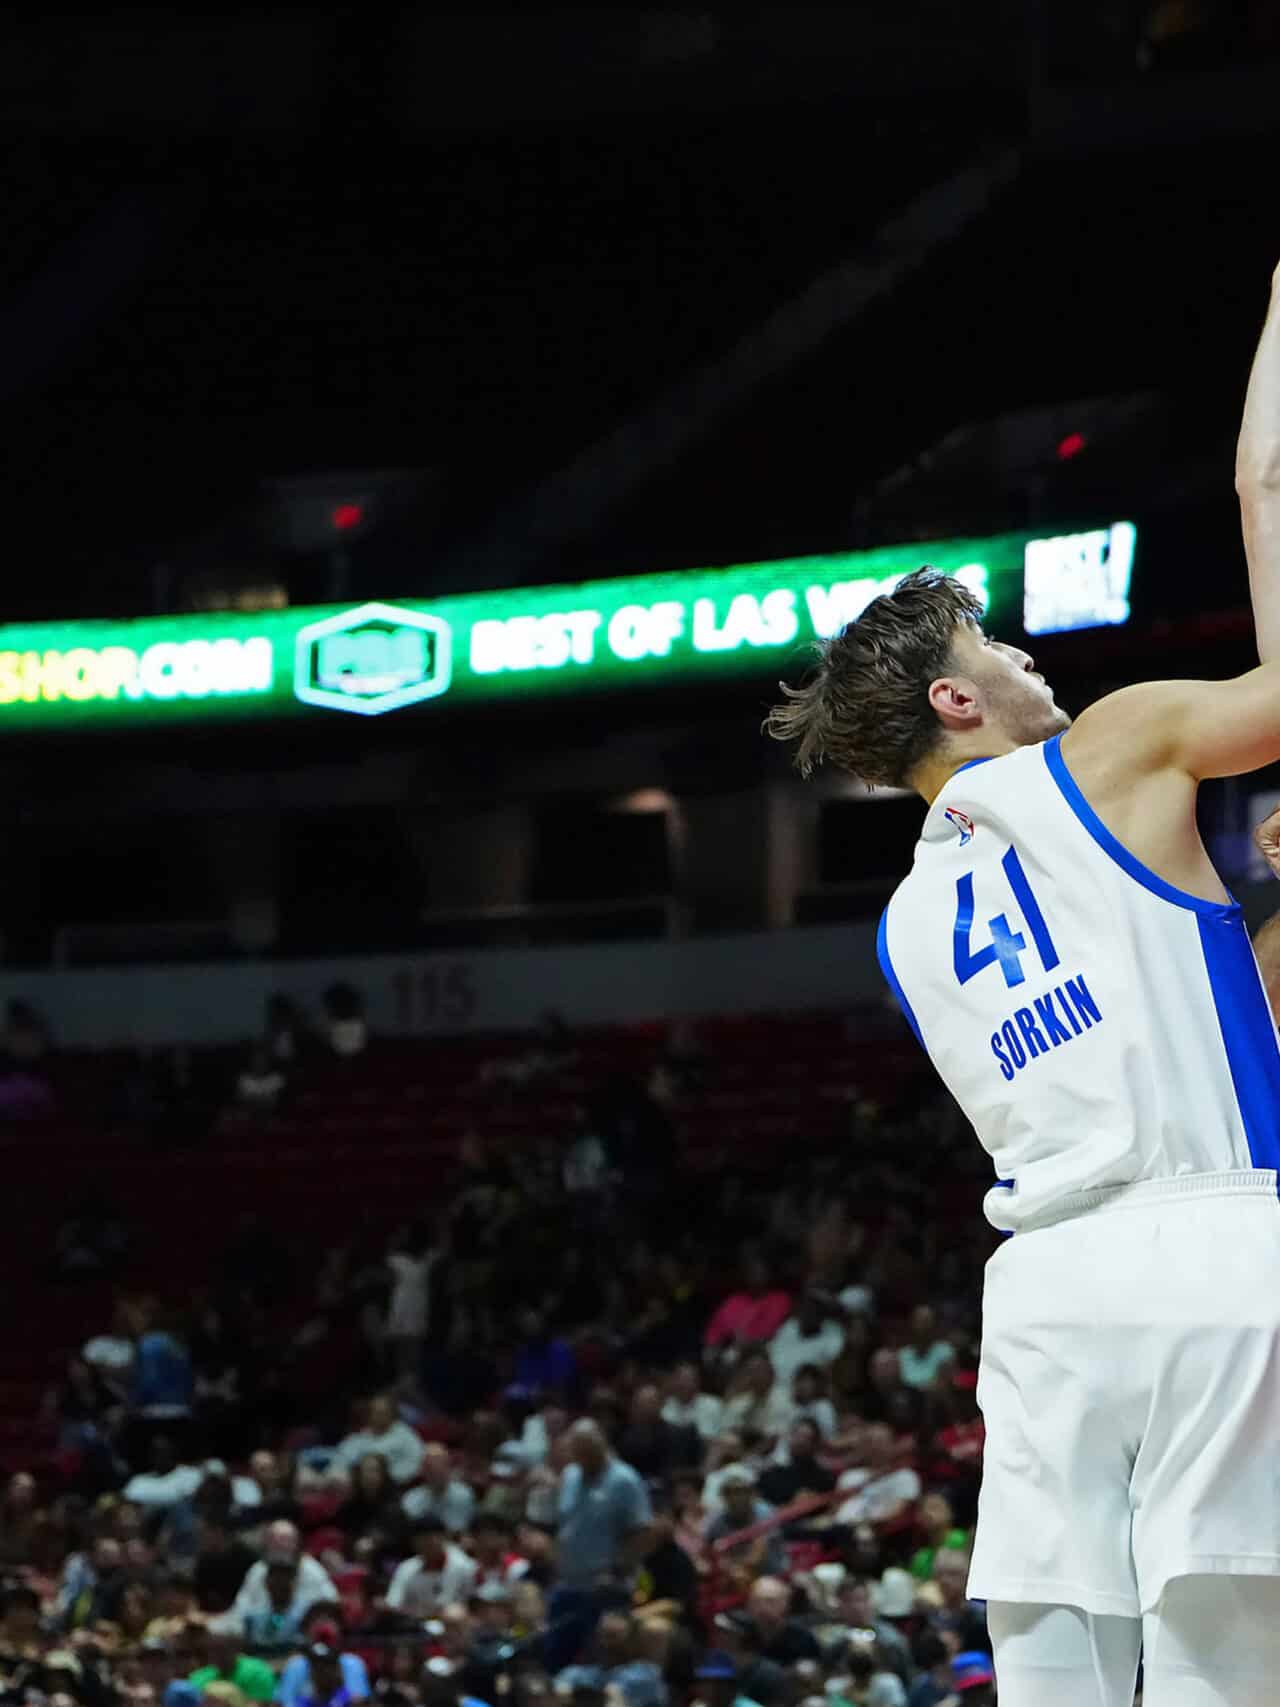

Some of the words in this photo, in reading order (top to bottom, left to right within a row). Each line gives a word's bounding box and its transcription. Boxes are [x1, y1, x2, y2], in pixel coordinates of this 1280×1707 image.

[470, 610, 602, 675] BEST
[607, 601, 686, 661] OF
[693, 588, 797, 652] LAS
[952, 842, 1061, 989] 41
[390, 966, 476, 1019] 115
[990, 973, 1103, 1081] SORKIN
